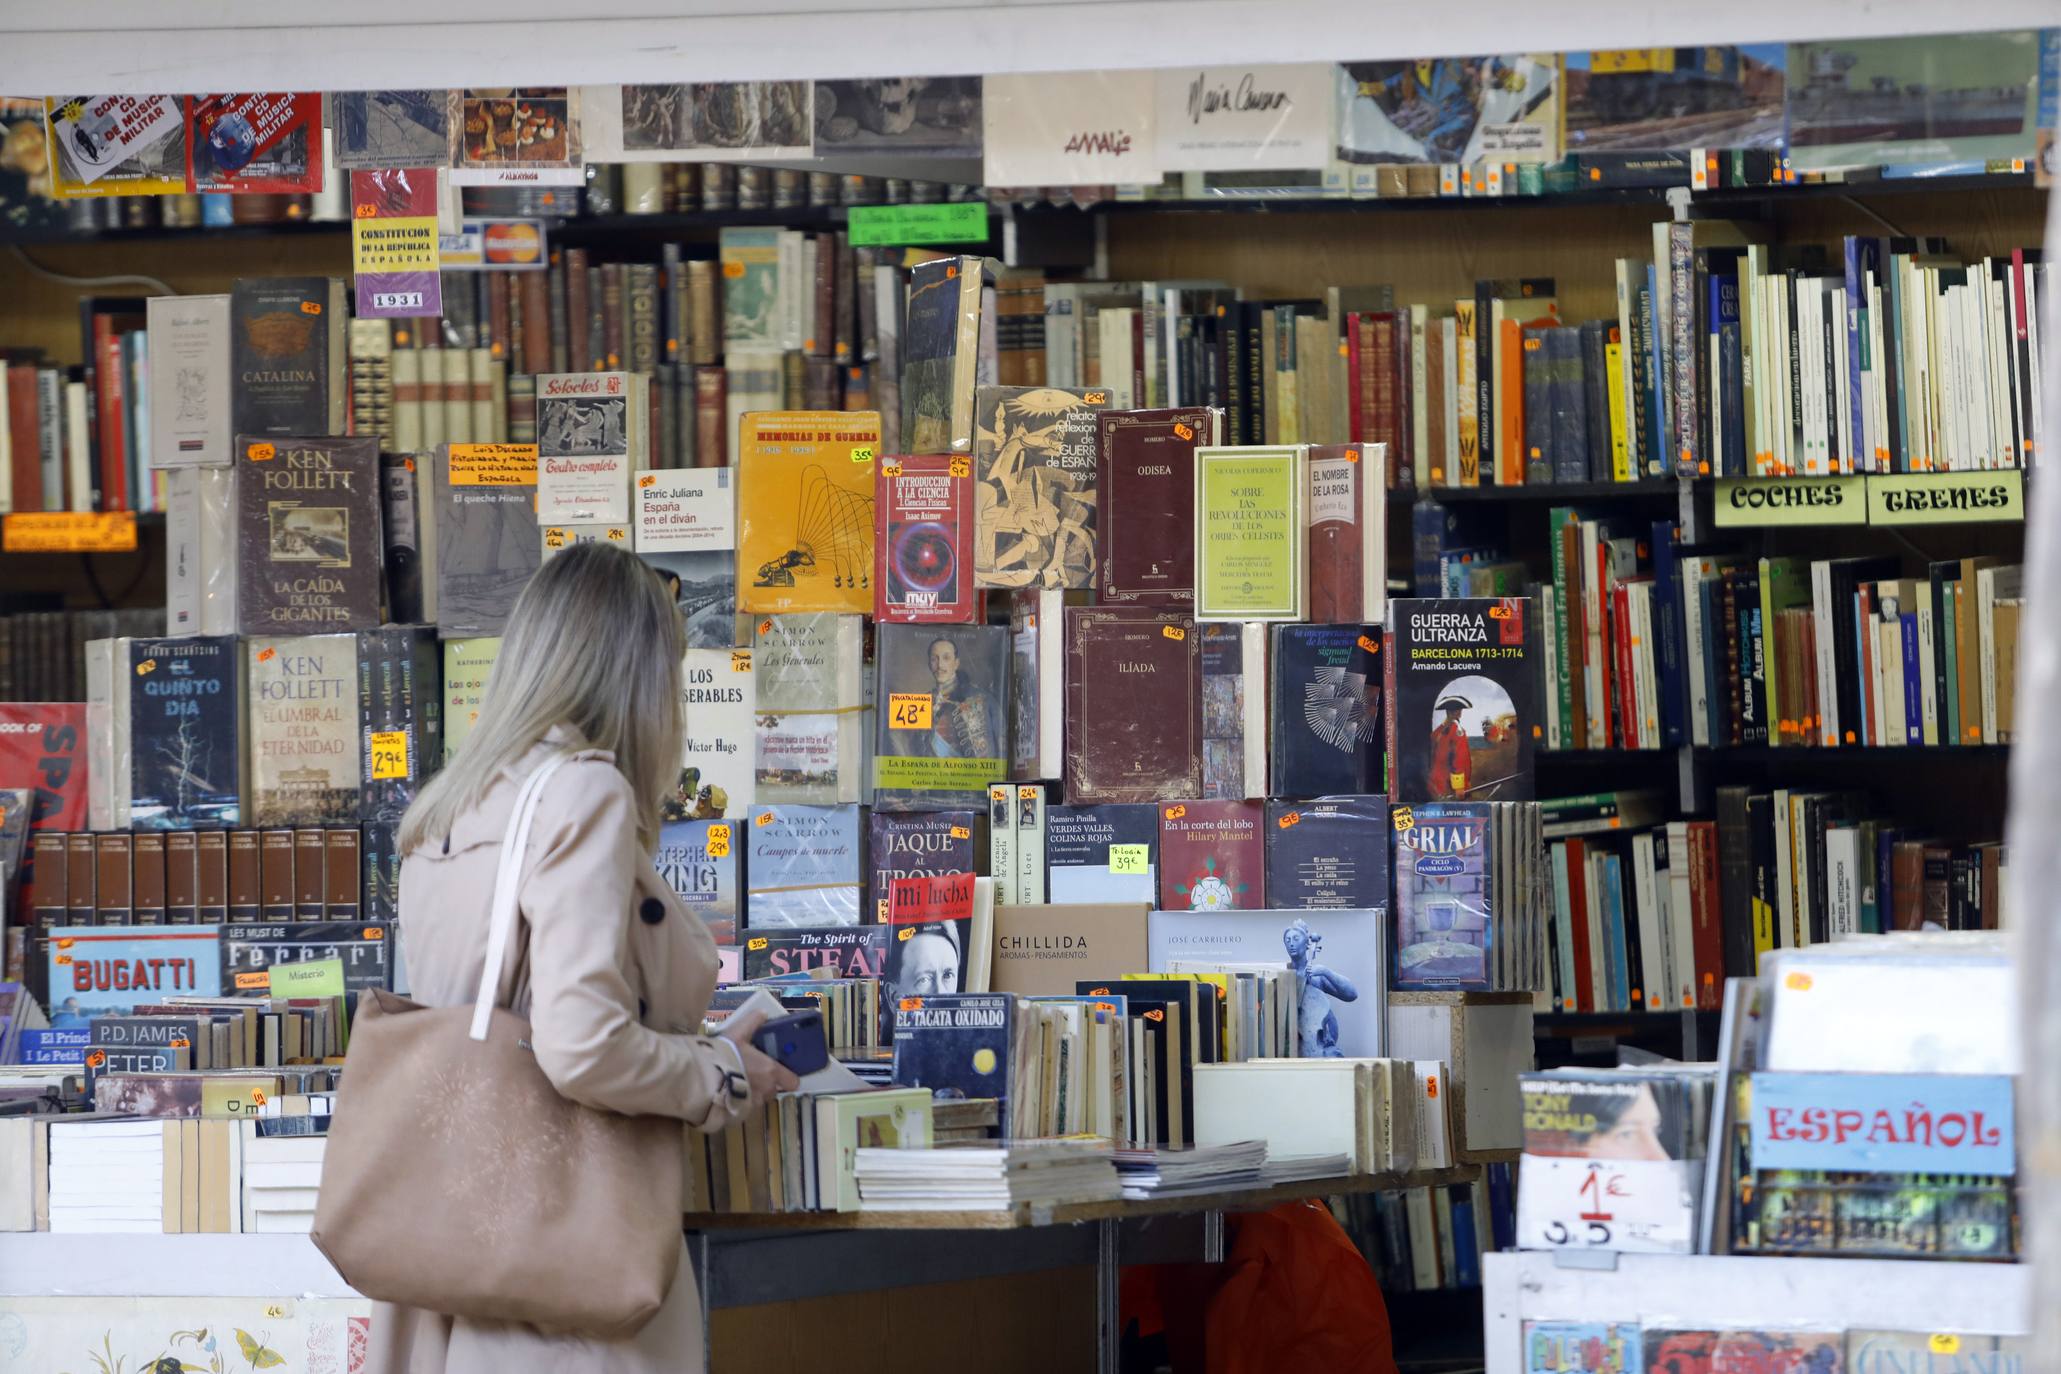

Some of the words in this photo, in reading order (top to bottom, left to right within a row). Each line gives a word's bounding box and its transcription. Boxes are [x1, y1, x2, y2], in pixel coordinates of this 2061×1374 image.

[120, 96, 136, 113] CD
[254, 101, 271, 116] CD
[257, 91, 296, 129] MUSICA
[120, 107, 165, 145] MILITAR
[254, 107, 295, 146] MILITAR
[361, 243, 373, 252] DE
[374, 243, 385, 252] LA
[361, 252, 431, 263] ESPAÑOLA
[376, 293, 421, 307] 1931
[242, 369, 316, 384] CATALINA
[757, 432, 813, 441] MEMORIAS
[818, 432, 831, 441] DE
[836, 432, 877, 442] GUERRA
[1080, 435, 1094, 444] de
[287, 451, 333, 469] KEN
[855, 450, 873, 461] 35€
[1138, 465, 1172, 475] ODISEA
[1313, 471, 1321, 481] EL
[1322, 468, 1349, 480] NOMBRE
[264, 471, 354, 490] FOLLETT
[895, 476, 951, 488] INTRODUCCION
[643, 489, 668, 499] Enric
[669, 488, 703, 499] Juliana
[897, 488, 903, 498] A
[904, 488, 917, 498] LA
[918, 488, 950, 498] CIENCIA
[1231, 487, 1264, 497] SOBRE
[1313, 486, 1321, 496] DE
[1322, 486, 1330, 496] LA
[1332, 484, 1349, 495] ROSA
[1730, 484, 1844, 509] COCHES
[1239, 500, 1256, 508] LAS
[1882, 485, 2009, 512] TRENES
[643, 501, 680, 515] España
[643, 515, 656, 525] en
[658, 514, 668, 525] el
[670, 513, 697, 525] diván
[905, 512, 920, 520] Isaac
[921, 512, 941, 520] Asimov
[1209, 510, 1286, 520] REVOLUCIONES
[1232, 522, 1244, 530] DE
[1248, 522, 1263, 530] LOS
[1242, 531, 1284, 540] CELESTES
[274, 582, 291, 593] LA
[293, 576, 345, 593] CAÍDA
[290, 595, 306, 606] DE
[308, 595, 331, 606] LOS
[906, 593, 936, 607] muy
[271, 607, 350, 621] GIGANTES
[1411, 614, 1471, 628] GUERRA
[1474, 614, 1485, 627] A
[1751, 607, 1761, 635] MINI
[774, 627, 816, 635] SIMON
[1411, 628, 1487, 642] ULTRANZA
[764, 638, 826, 647] SCARROW
[1318, 646, 1353, 656] sigmund
[1412, 649, 1473, 659] BARCELONA
[1476, 648, 1523, 658] 1713-1714
[1327, 656, 1350, 665] freud
[1753, 637, 1764, 680] ALBUM
[281, 656, 324, 676] KEN
[1119, 661, 1155, 673] ILÍADA
[1412, 661, 1446, 670] Amando
[1448, 662, 1481, 670] Lacueva
[690, 669, 713, 683] LOS
[145, 680, 220, 696] QUINTO
[261, 679, 345, 700] FOLLETT
[1743, 678, 1753, 722] ALBUM
[263, 711, 276, 723] EL
[278, 707, 342, 723] UMBRAL
[895, 705, 925, 725] 48€
[287, 726, 302, 737] DE
[303, 726, 319, 737] LA
[262, 740, 345, 755] ETERNIDAD
[716, 738, 737, 755] Hugo
[374, 751, 403, 774] 29€
[888, 760, 898, 768] LA
[901, 759, 928, 768] ESPAÑA
[943, 760, 977, 768] ALFONSO
[980, 761, 998, 769] XIII
[777, 816, 830, 825] SIMON
[1050, 815, 1075, 823] Ramiro
[1076, 814, 1097, 822] Pinilla
[1165, 821, 1178, 830] En
[1180, 821, 1189, 830] la
[1191, 820, 1214, 830] corte
[1217, 820, 1232, 829] del
[1234, 819, 1254, 829] lobo
[1282, 814, 1298, 826] 9€
[764, 829, 842, 838] SCARROW
[1051, 825, 1082, 833] VERDES
[1084, 824, 1115, 833] VALLES,
[1051, 834, 1086, 843] COLINAS
[1088, 834, 1113, 843] ROJAS
[1187, 831, 1217, 842] Hilary
[1220, 831, 1254, 841] Mantel
[1403, 826, 1479, 854] GRIAL
[709, 843, 728, 854] 29€
[887, 834, 954, 853] JAQUE
[915, 857, 925, 866] AL
[1116, 857, 1138, 870] 39€
[1001, 869, 1007, 878] de
[1836, 861, 1844, 903] HITCHCOCK
[896, 885, 922, 907] mi
[928, 882, 969, 905] lucha
[1838, 905, 1846, 934] ALFRED
[230, 928, 245, 938] LES
[246, 928, 270, 937] MUST
[273, 928, 286, 937] DE
[800, 934, 822, 946] The
[824, 934, 856, 948] Spirit
[859, 933, 873, 945] of
[1000, 936, 1088, 949] CHILLIDA
[1000, 951, 1031, 959] AROMAS
[1035, 950, 1088, 959] PENSAMIENTOS
[73, 958, 196, 992] BUGATTI
[288, 969, 325, 981] Misterio
[896, 1012, 911, 1027] EL
[955, 1009, 1004, 1026] OXIDADO
[100, 1026, 129, 1041] P.D.
[132, 1026, 187, 1042] JAMES
[36, 1051, 49, 1062] Le
[52, 1050, 79, 1062] Petit
[91, 1055, 167, 1079] PETER
[1766, 1101, 2001, 1148] ESPAÑOL
